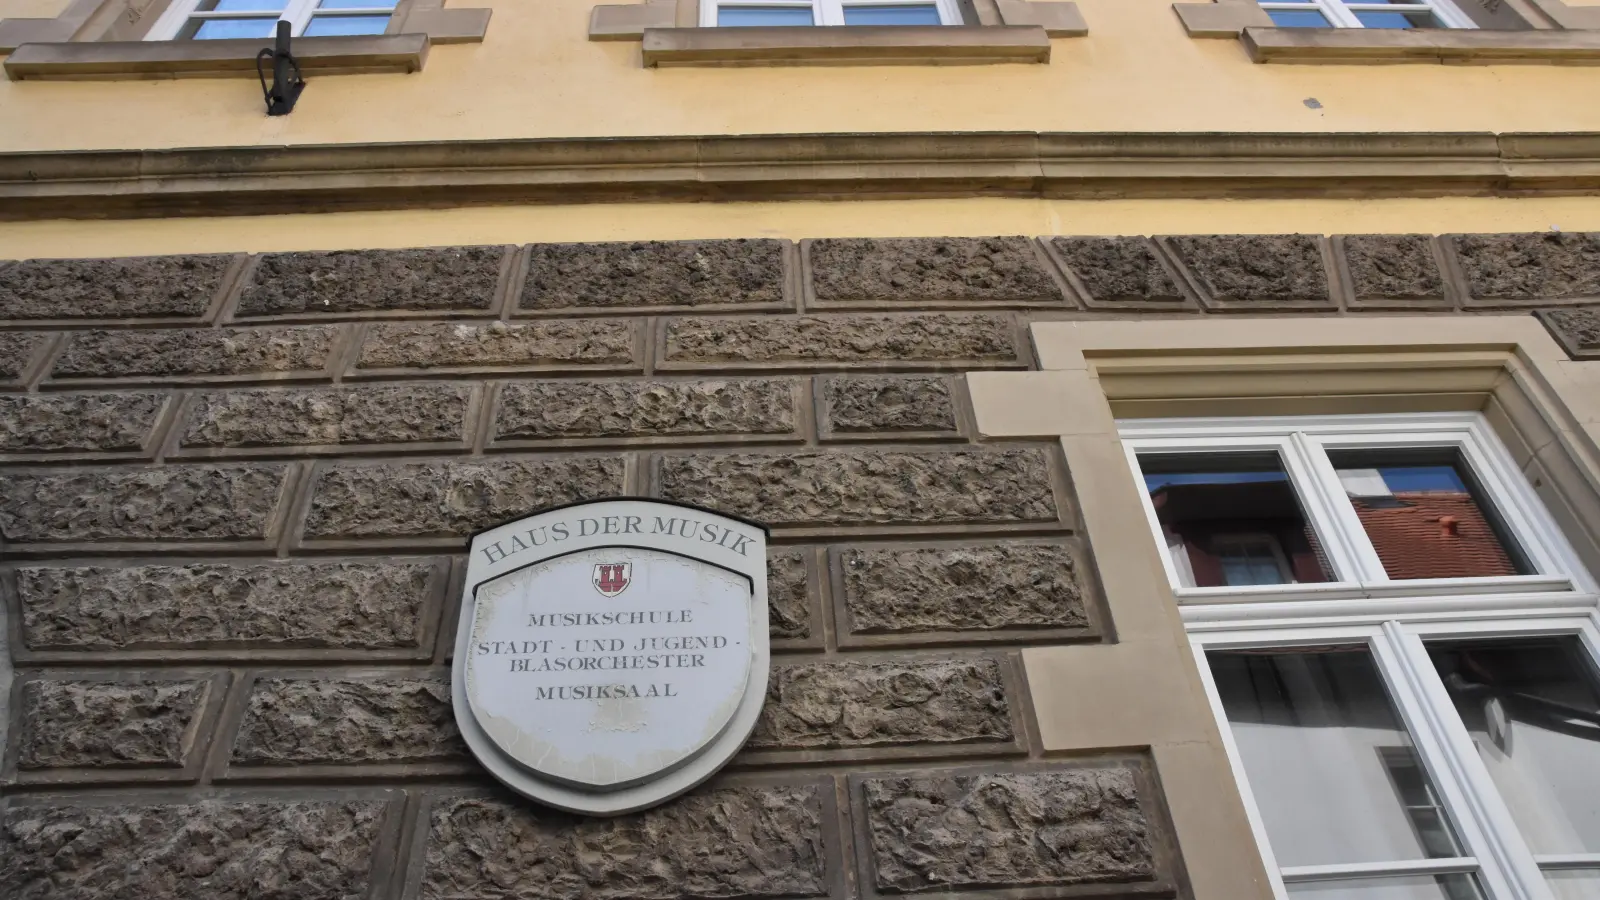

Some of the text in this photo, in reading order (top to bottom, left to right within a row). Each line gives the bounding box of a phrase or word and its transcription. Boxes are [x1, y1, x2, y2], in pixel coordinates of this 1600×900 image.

[480, 515, 757, 565] HAUS DER MUSIK
[527, 610, 693, 627] MUSIKSCHULE
[575, 638, 625, 653] UND
[509, 654, 706, 673] BLASORCHESTER
[535, 683, 678, 701] MUSIKSAAL
